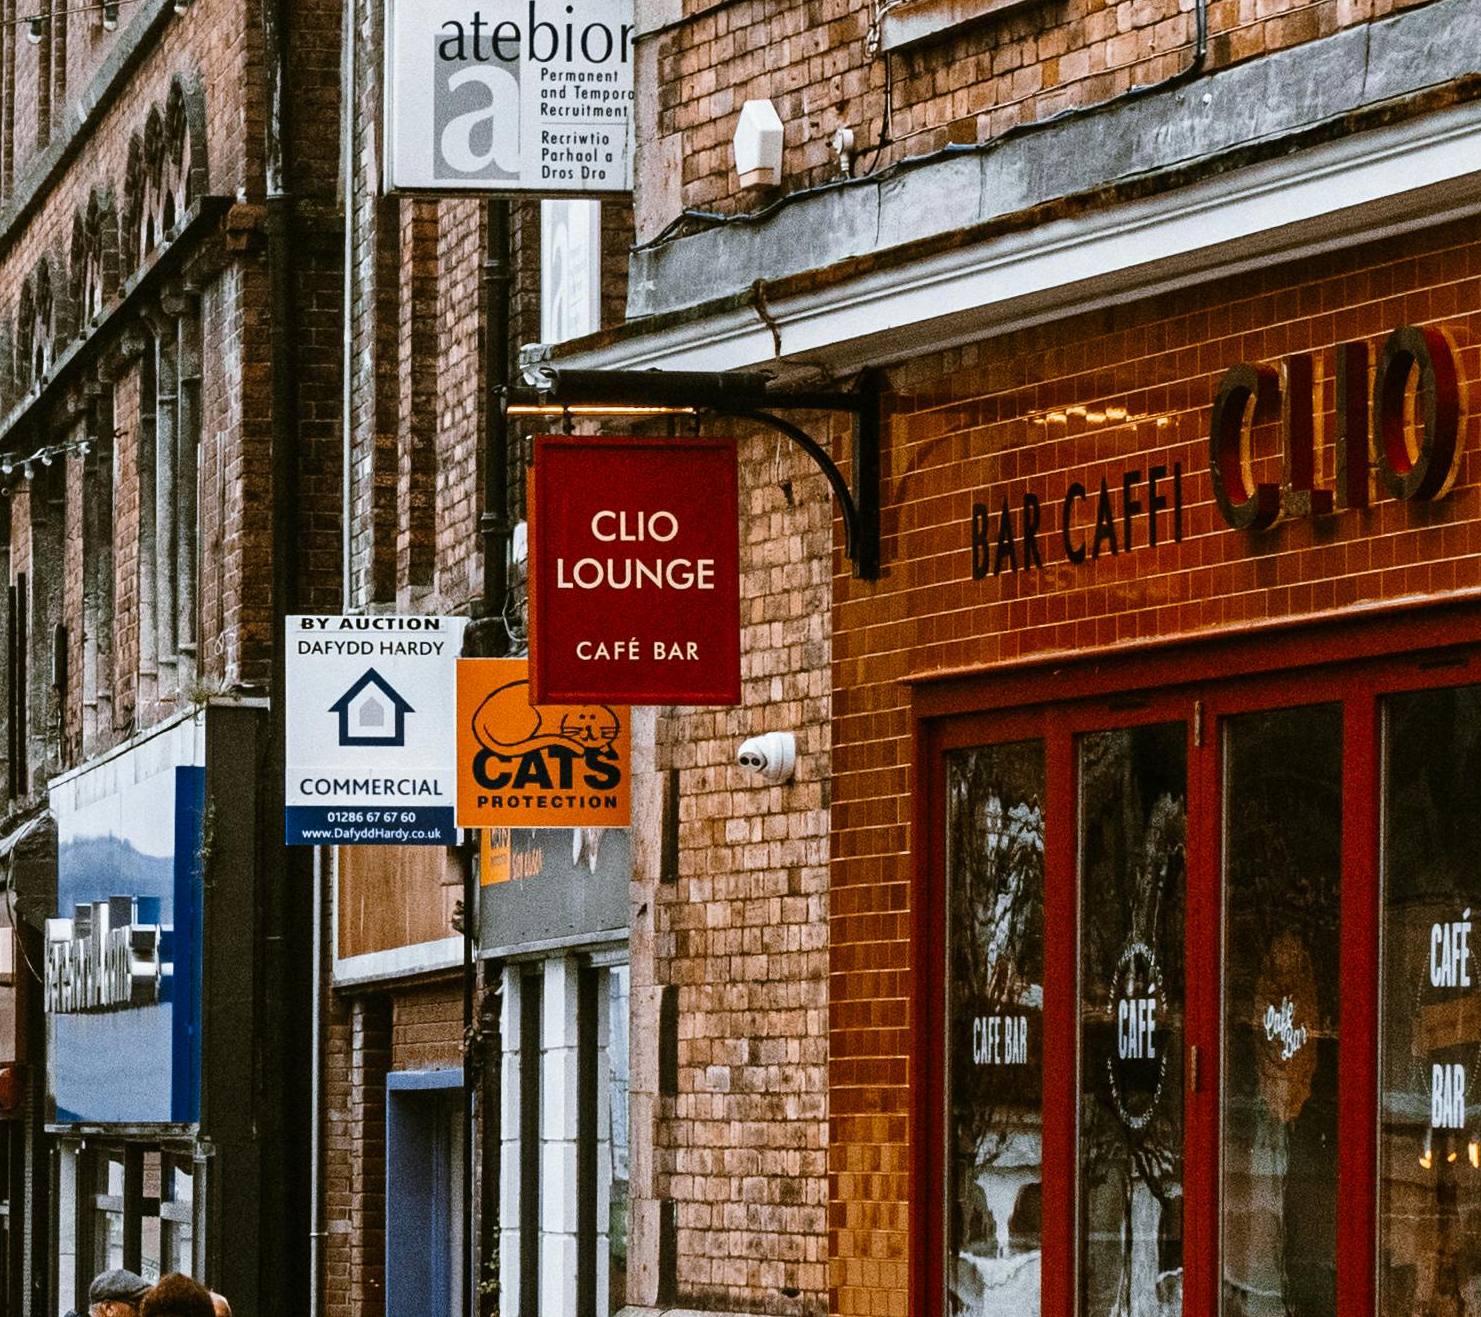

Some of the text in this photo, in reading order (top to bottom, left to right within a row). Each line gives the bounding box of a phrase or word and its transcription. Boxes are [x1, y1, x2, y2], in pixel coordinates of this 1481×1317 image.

[540, 67, 619, 83] Permanent
[540, 85, 567, 100] and
[540, 103, 628, 117] Recruitment
[540, 130, 610, 145] Recriwtio
[540, 148, 614, 163] Parhaol a
[540, 165, 606, 180] Dros Dro
[1209, 323, 1462, 533] CLIO
[591, 509, 679, 543] CLIO
[970, 461, 1185, 581] BAR CAFFI
[557, 557, 716, 591] LOUNGE
[300, 618, 441, 631] BY AUCTION
[297, 640, 445, 657] DAFYDD HARDY
[575, 636, 700, 661] CAFÉ BAR
[472, 746, 622, 791] CATS
[299, 778, 444, 797] COMMERCIAL
[477, 795, 618, 810] PROTECTION
[327, 811, 416, 824] 01286 67 67 60
[301, 827, 442, 843] www.DafyddHardy.co.uk
[1429, 906, 1472, 988] CAFÉ
[1117, 982, 1157, 1060] CAFÉ
[1004, 1015, 1028, 1065] BAR
[1431, 1063, 1466, 1129] BAR
